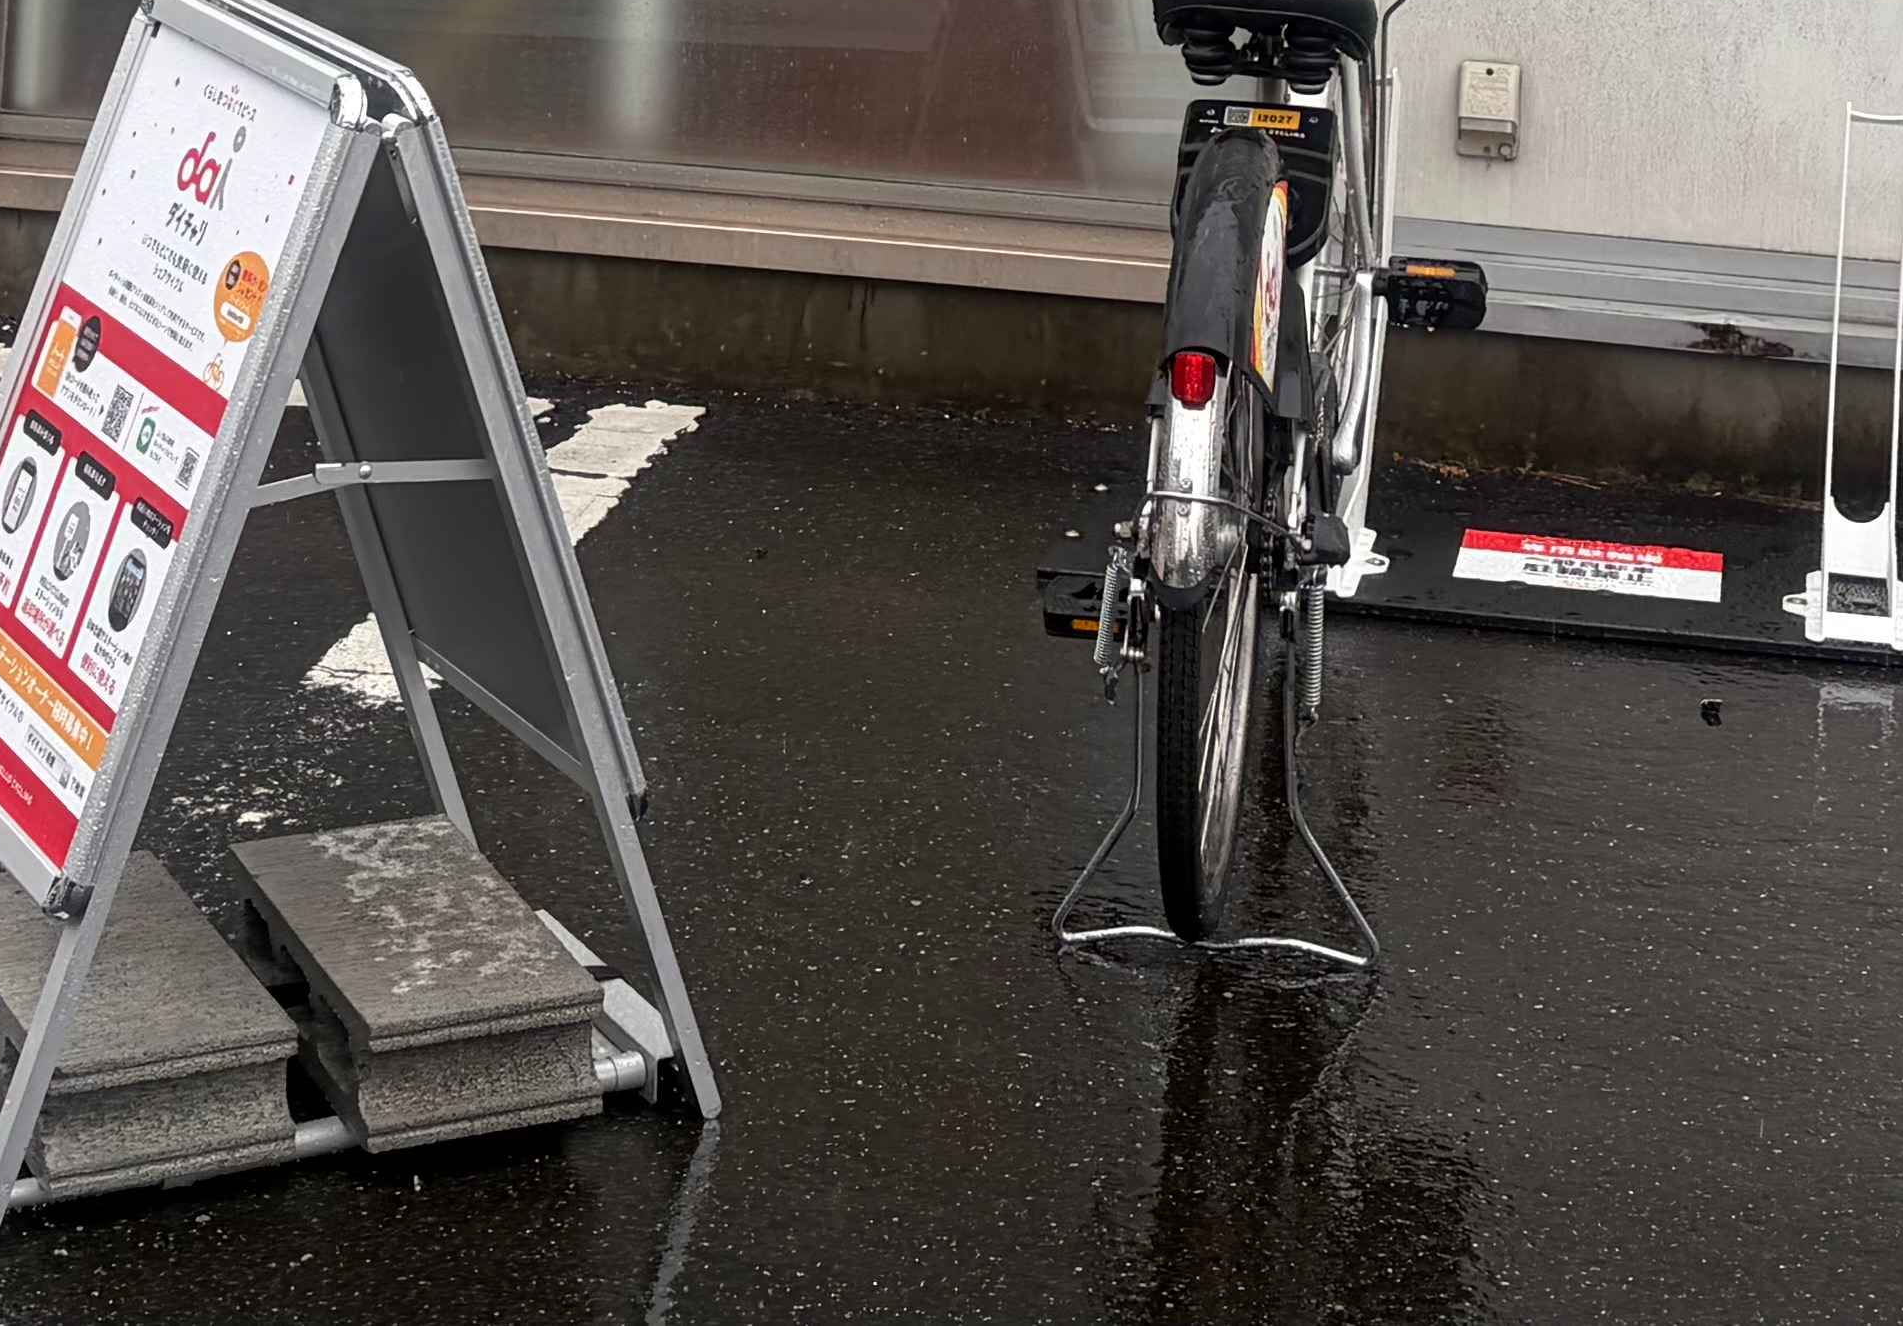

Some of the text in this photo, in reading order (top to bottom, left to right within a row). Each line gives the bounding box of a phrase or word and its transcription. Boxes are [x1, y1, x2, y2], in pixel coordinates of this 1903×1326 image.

[1257, 112, 1293, 125] 12027
[165, 201, 209, 247] ダイチャリ
